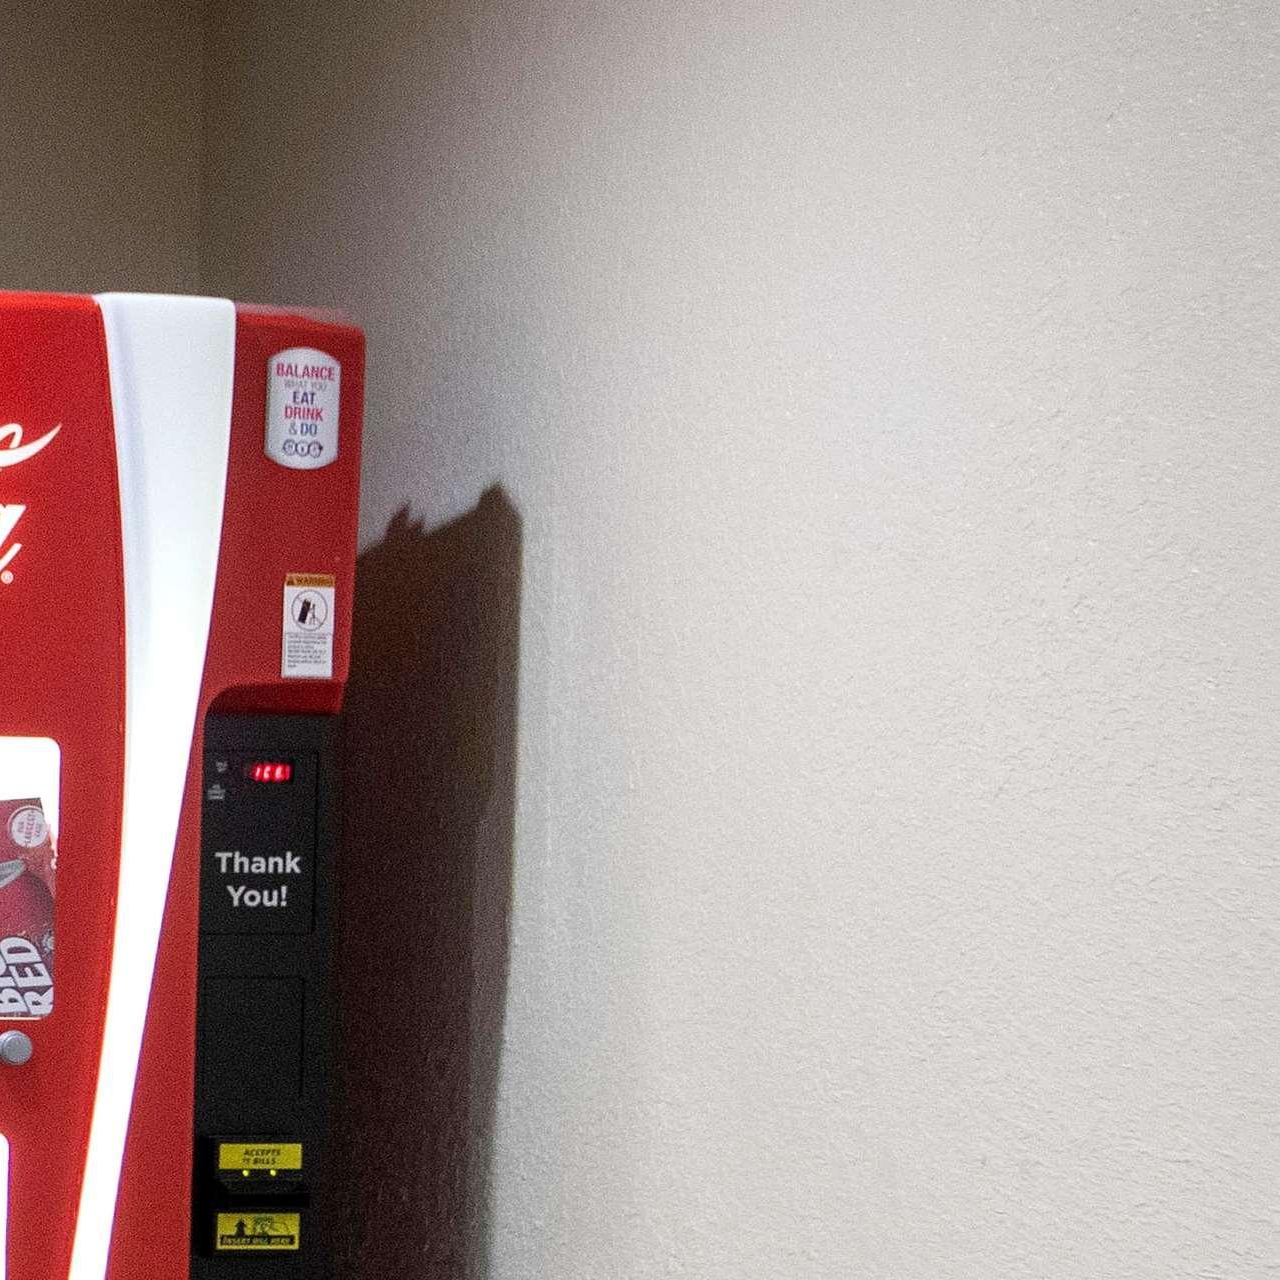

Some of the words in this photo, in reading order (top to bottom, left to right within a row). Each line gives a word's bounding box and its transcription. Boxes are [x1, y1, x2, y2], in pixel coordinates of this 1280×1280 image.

[276, 363, 335, 381] BALANCE
[293, 391, 316, 405] EAT
[284, 406, 323, 422] DRINK
[288, 422, 297, 435] &
[301, 422, 318, 436] DO
[214, 851, 301, 874] Thank
[226, 885, 288, 907] You!
[0, 936, 54, 1016] RED
